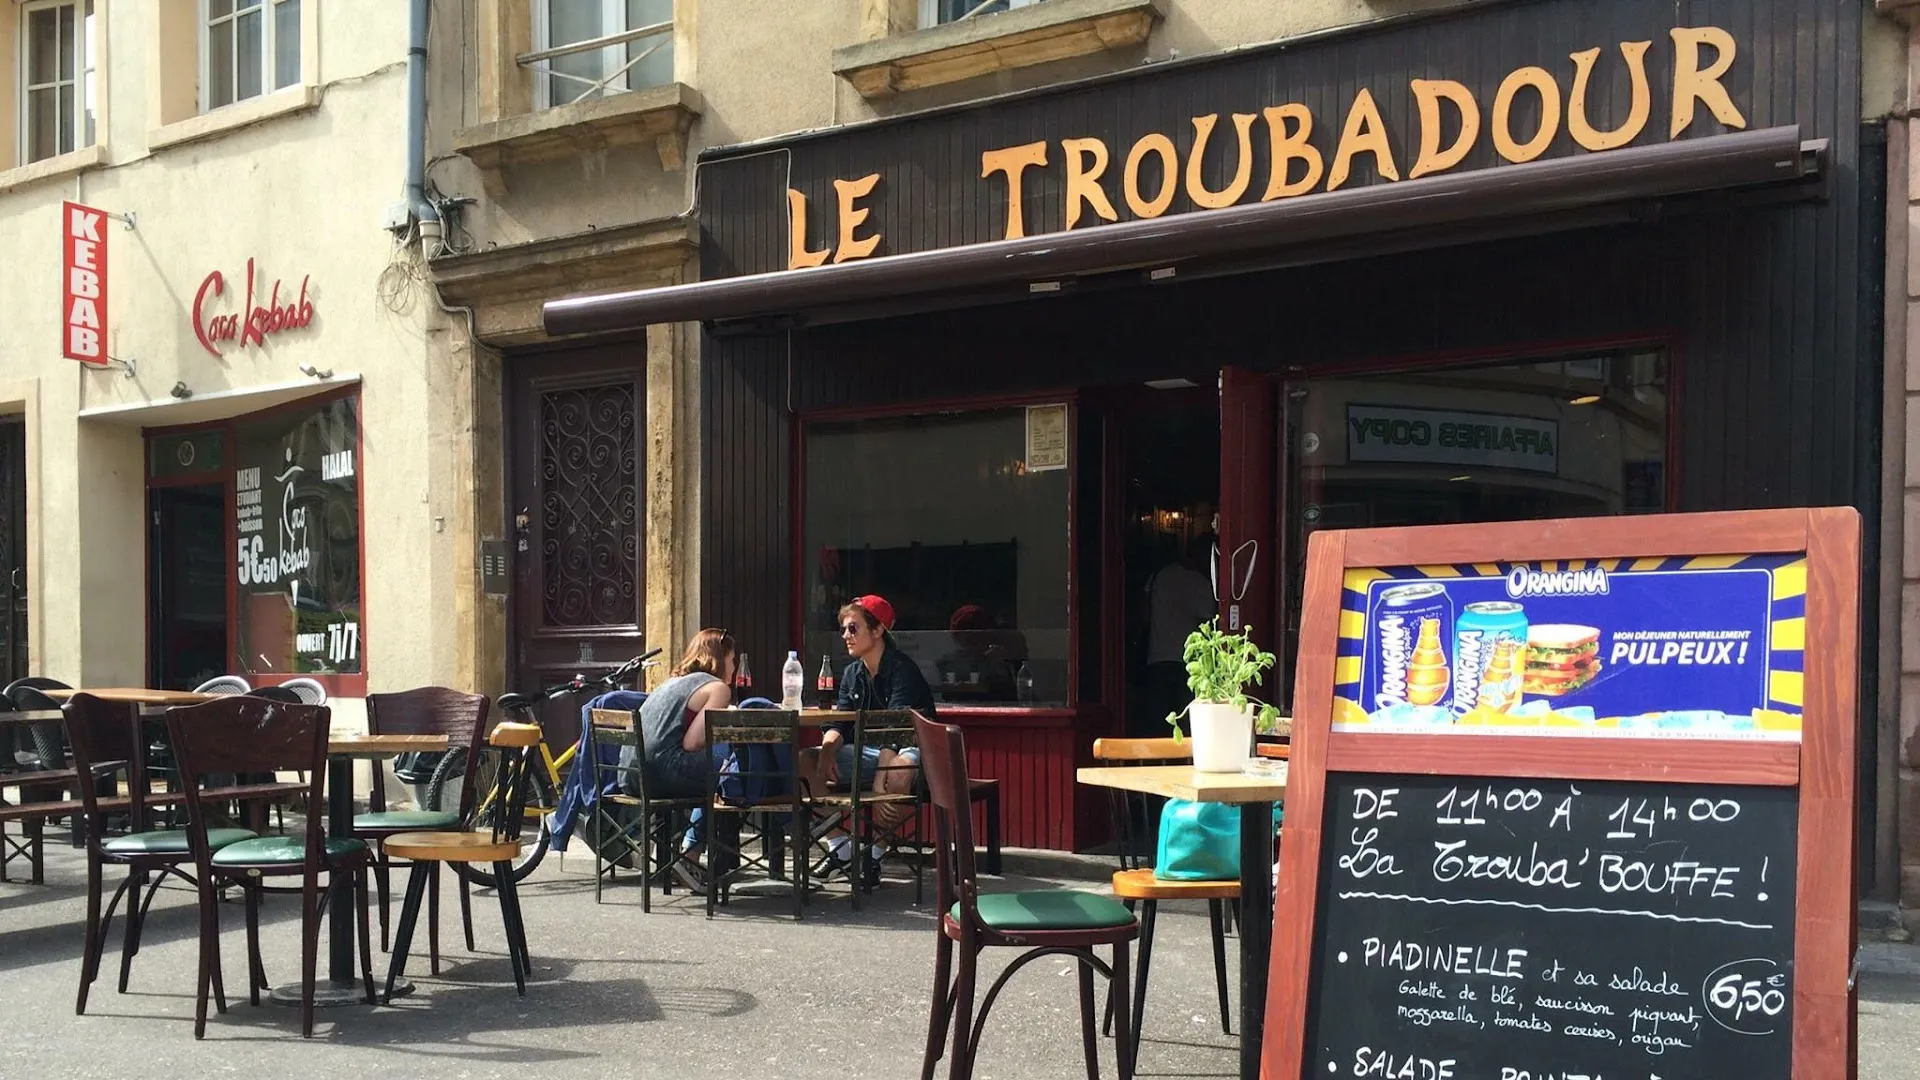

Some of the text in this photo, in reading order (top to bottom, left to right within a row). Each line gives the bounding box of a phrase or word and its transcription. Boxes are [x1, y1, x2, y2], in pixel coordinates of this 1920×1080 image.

[787, 26, 1746, 270] LE TROUBADOUR
[70, 208, 100, 358] KEBAB
[236, 467, 261, 491] MENU
[321, 449, 354, 481] HALAL
[296, 633, 326, 654] OUVERT
[1609, 641, 1736, 665] PULPEUX
[1612, 629, 1752, 641] MON DÉJEUNER NATURELLEMENT
[1352, 788, 1400, 820] DE
[1549, 783, 1582, 831] À
[1338, 826, 1404, 879] La
[1363, 936, 1690, 997] PIADINELLE et sa salade
[1397, 978, 1446, 999] Galette
[1457, 986, 1478, 1001] de
[1534, 994, 1615, 1016] saucisson
[1493, 1011, 1552, 1033] tomates
[1631, 1030, 1693, 1055] origan
